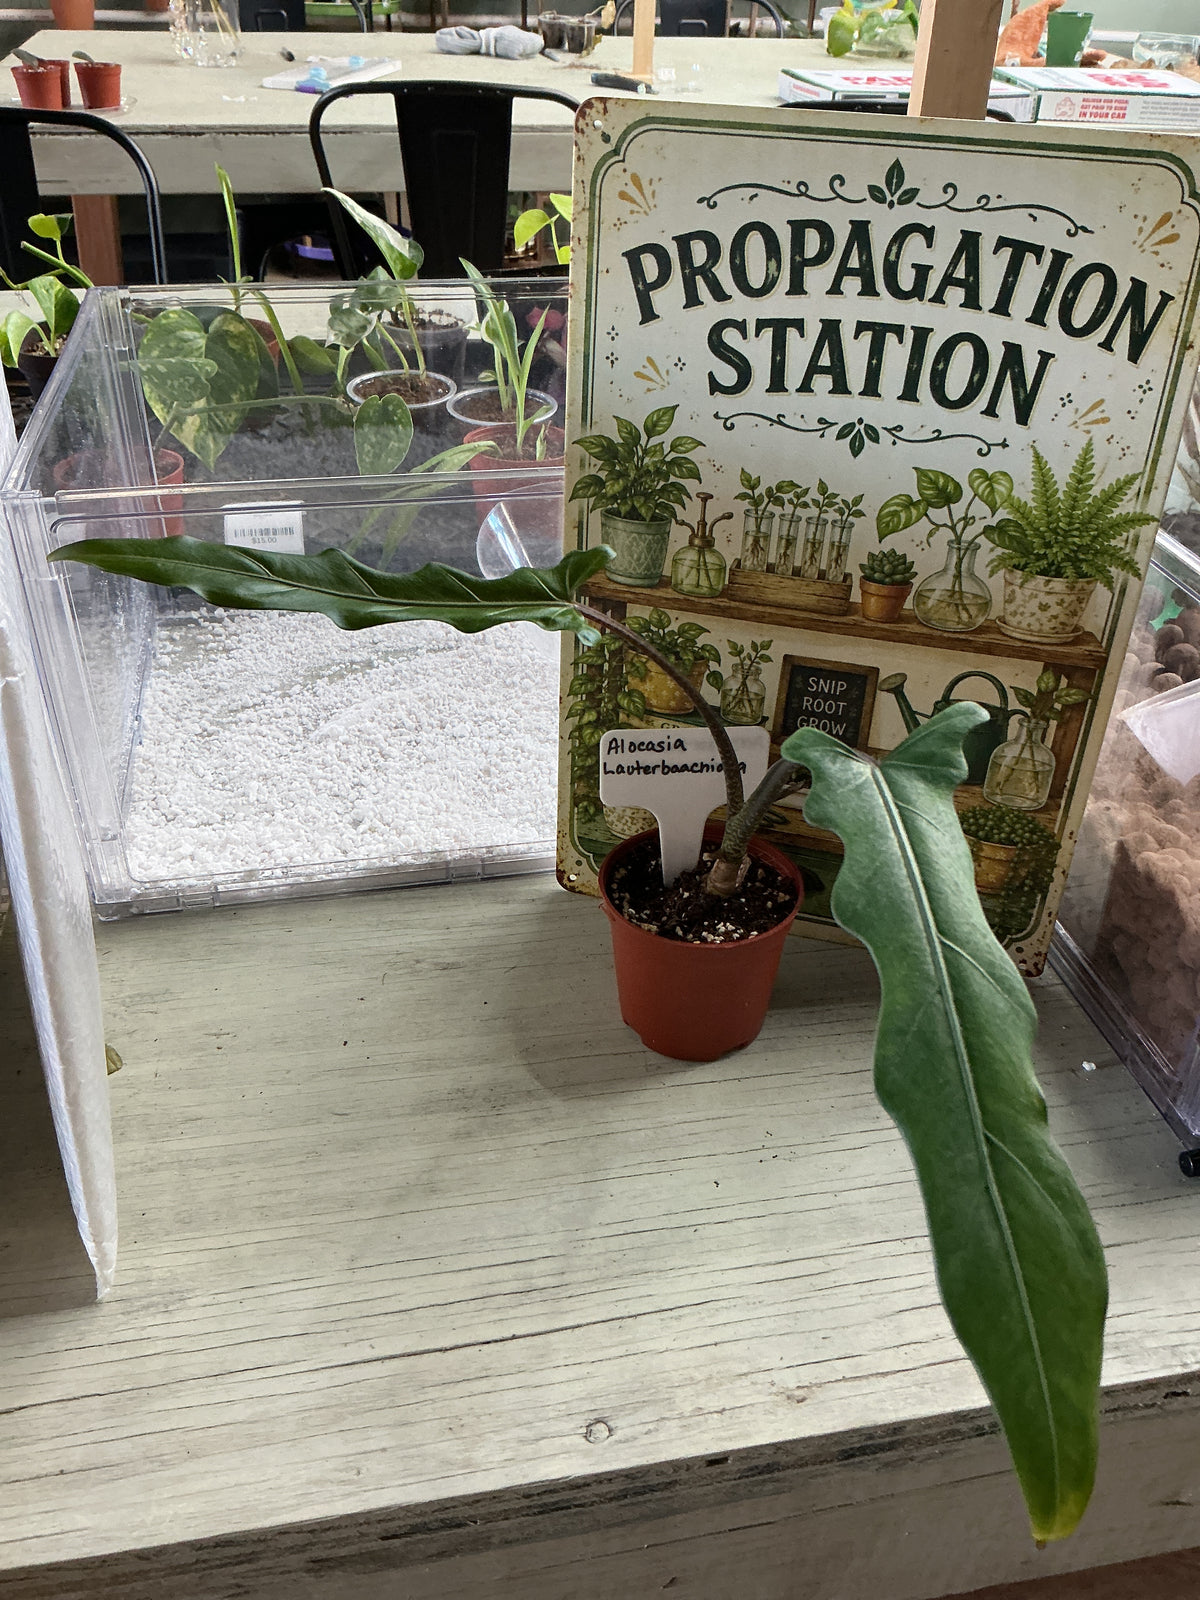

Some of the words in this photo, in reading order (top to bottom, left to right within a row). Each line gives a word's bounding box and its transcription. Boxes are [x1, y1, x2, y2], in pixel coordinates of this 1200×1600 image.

[622, 219, 1175, 366] PROPAGATION
[707, 318, 1056, 427] STATION
[807, 676, 847, 695] SNIP
[802, 696, 847, 716] ROOT
[797, 715, 846, 736] GROW
[607, 735, 687, 755] Alocasia
